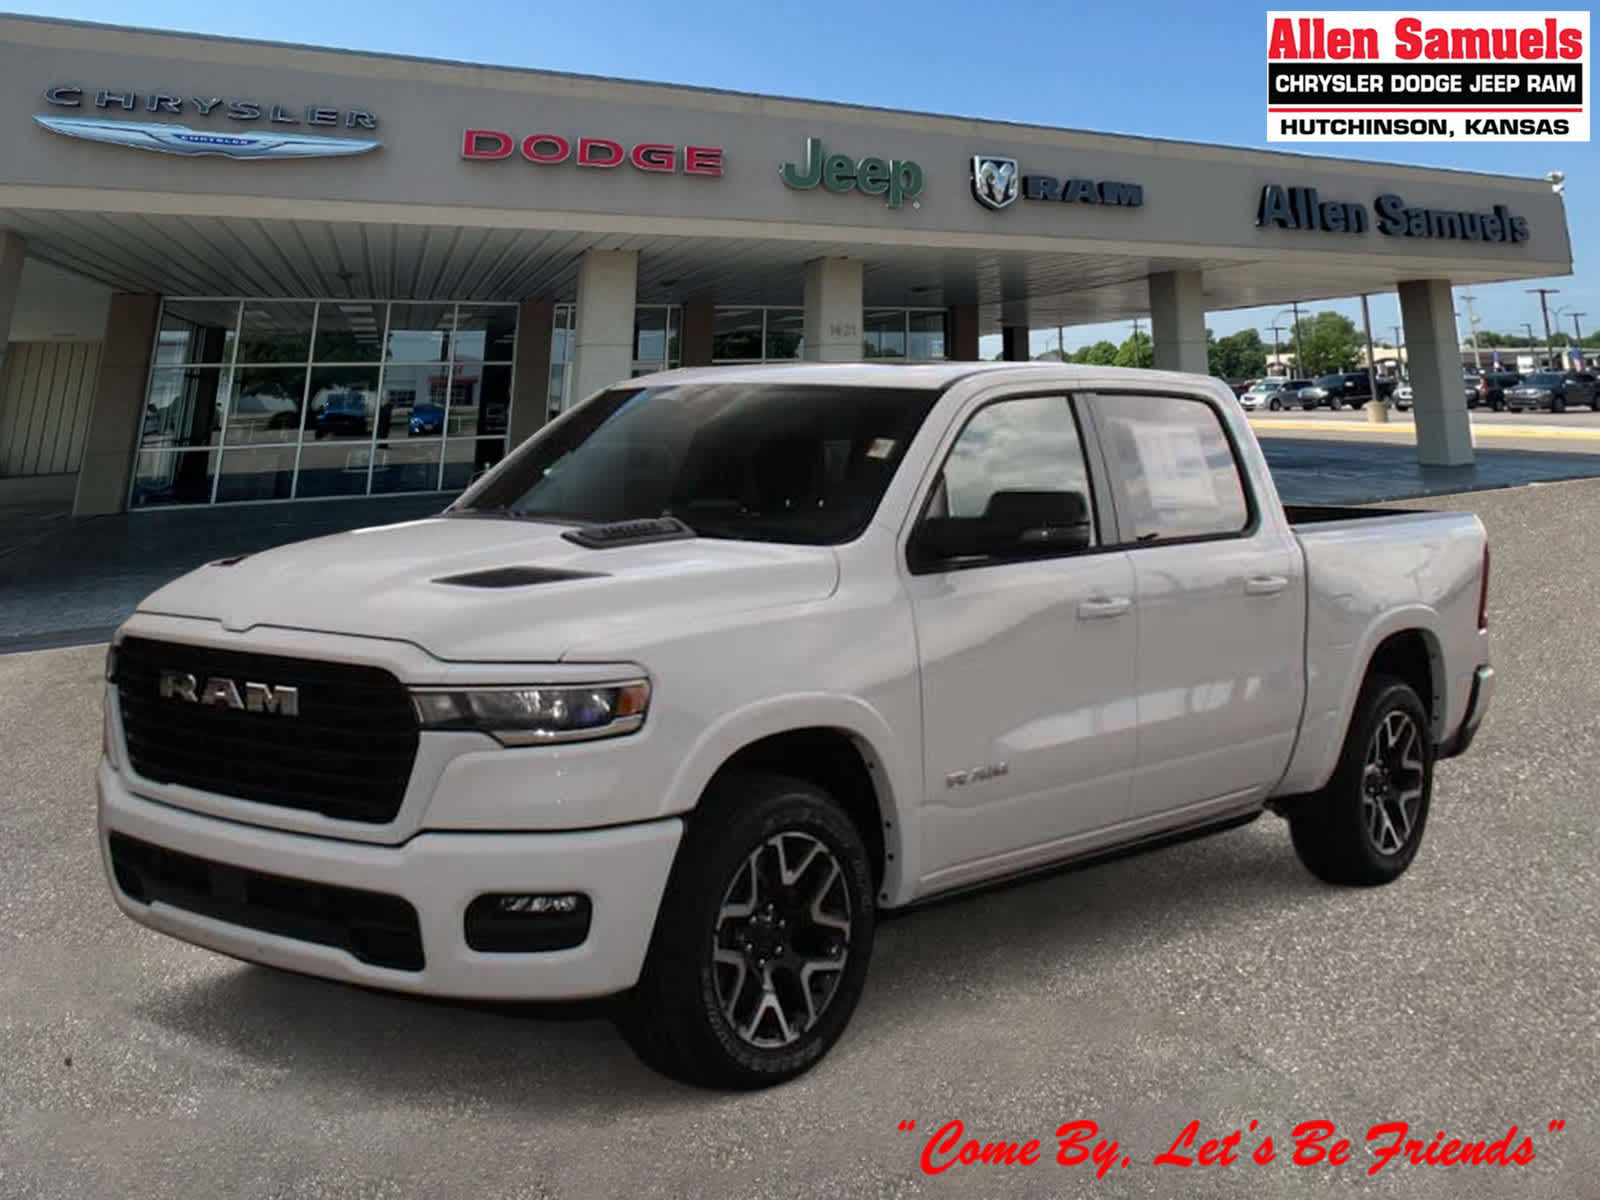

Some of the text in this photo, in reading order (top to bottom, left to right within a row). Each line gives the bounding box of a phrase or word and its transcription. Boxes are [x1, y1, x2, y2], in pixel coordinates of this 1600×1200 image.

[45, 86, 378, 129] CHRYSLER
[461, 128, 724, 176] DODGE
[779, 137, 924, 209] Jeep
[1022, 175, 1143, 207] RAM
[1256, 184, 1530, 243] Allen Samuels
[159, 669, 300, 716] RAM
